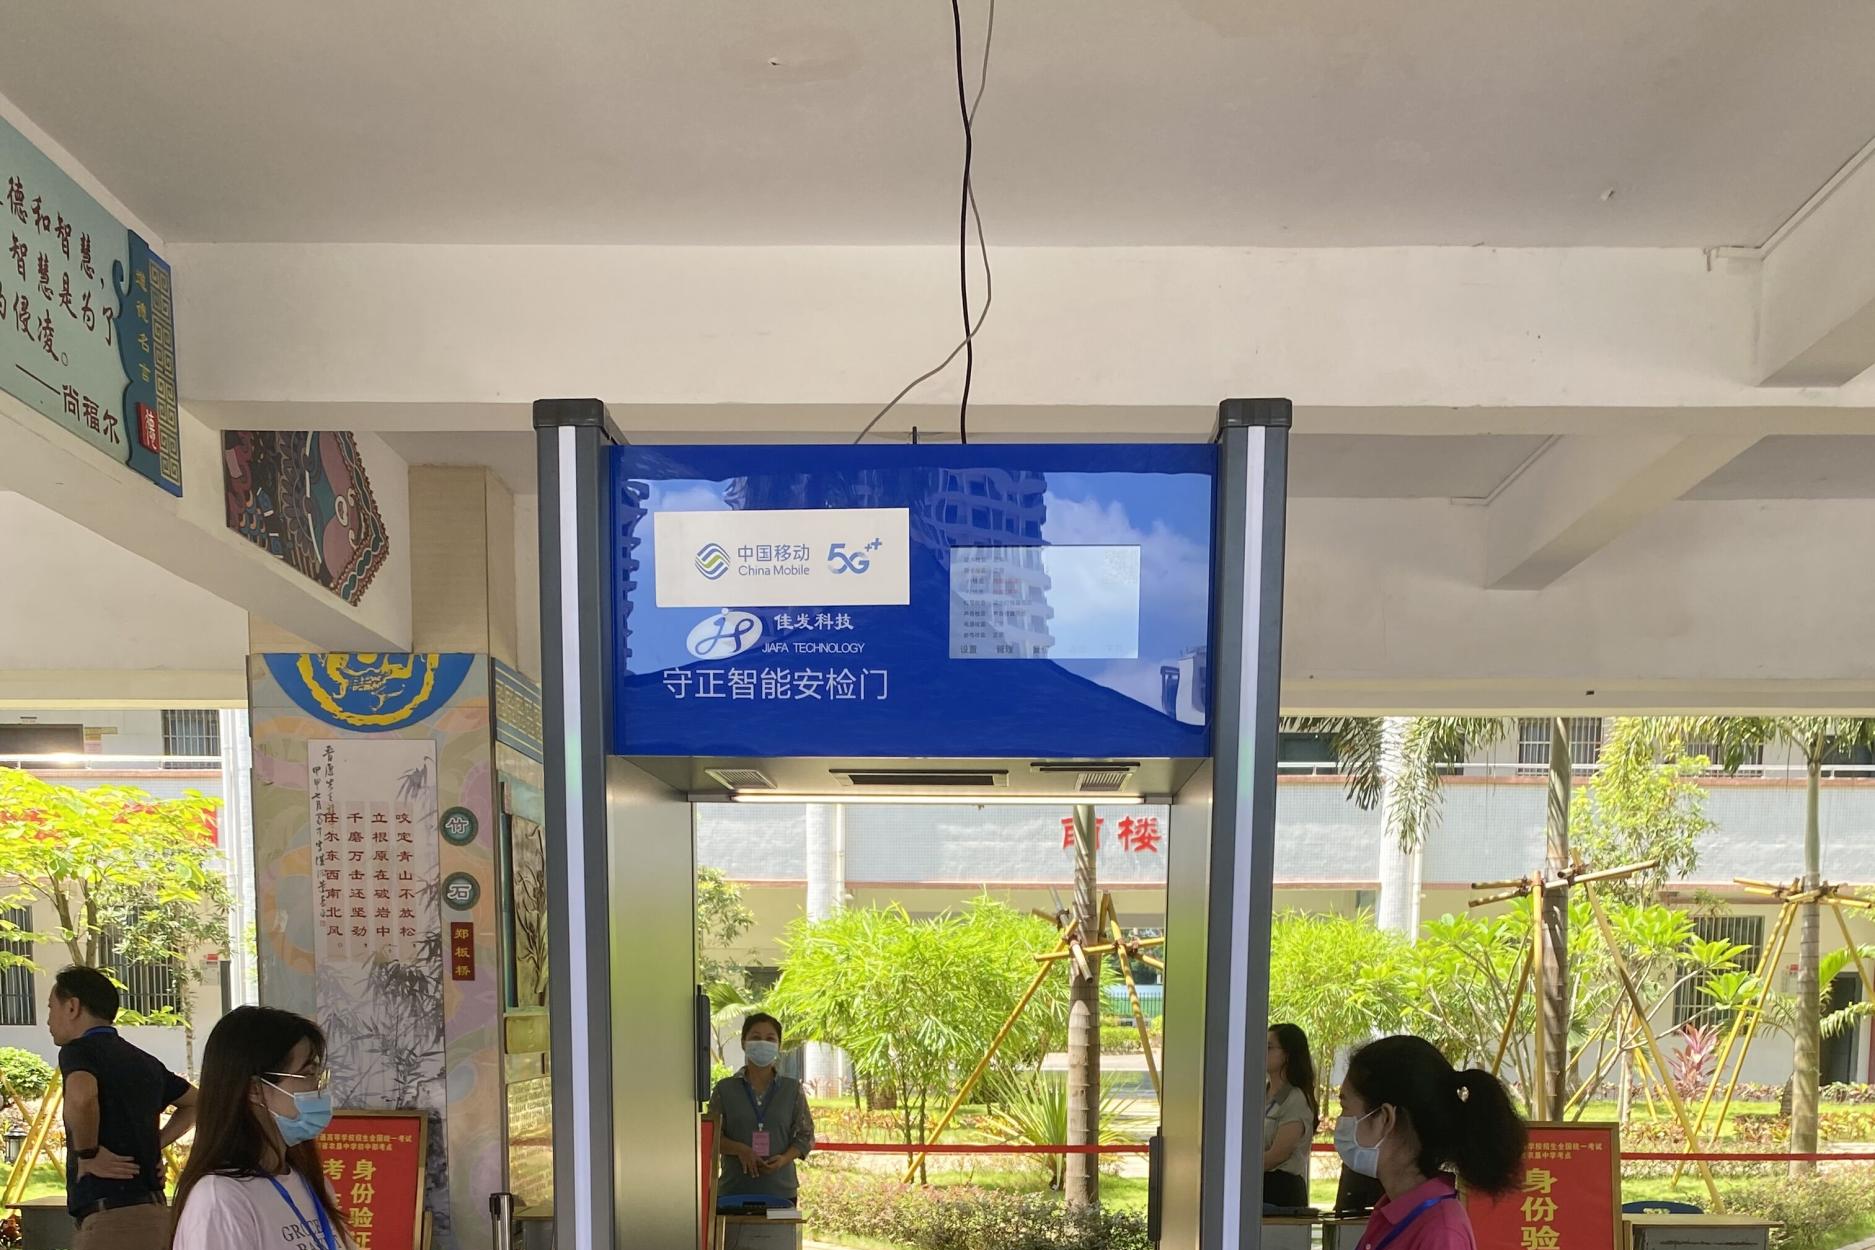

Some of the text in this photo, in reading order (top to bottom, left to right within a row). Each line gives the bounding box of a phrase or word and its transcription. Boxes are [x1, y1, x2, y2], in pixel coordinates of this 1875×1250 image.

[9, 232, 114, 346] 智慧是为了
[738, 544, 810, 562] 中国移动
[738, 565, 810, 576] China Mobile
[774, 613, 854, 630] 佳发科技
[762, 643, 866, 653] JIAFA TECHNOLOGY
[662, 667, 888, 700] 守正智能安检门
